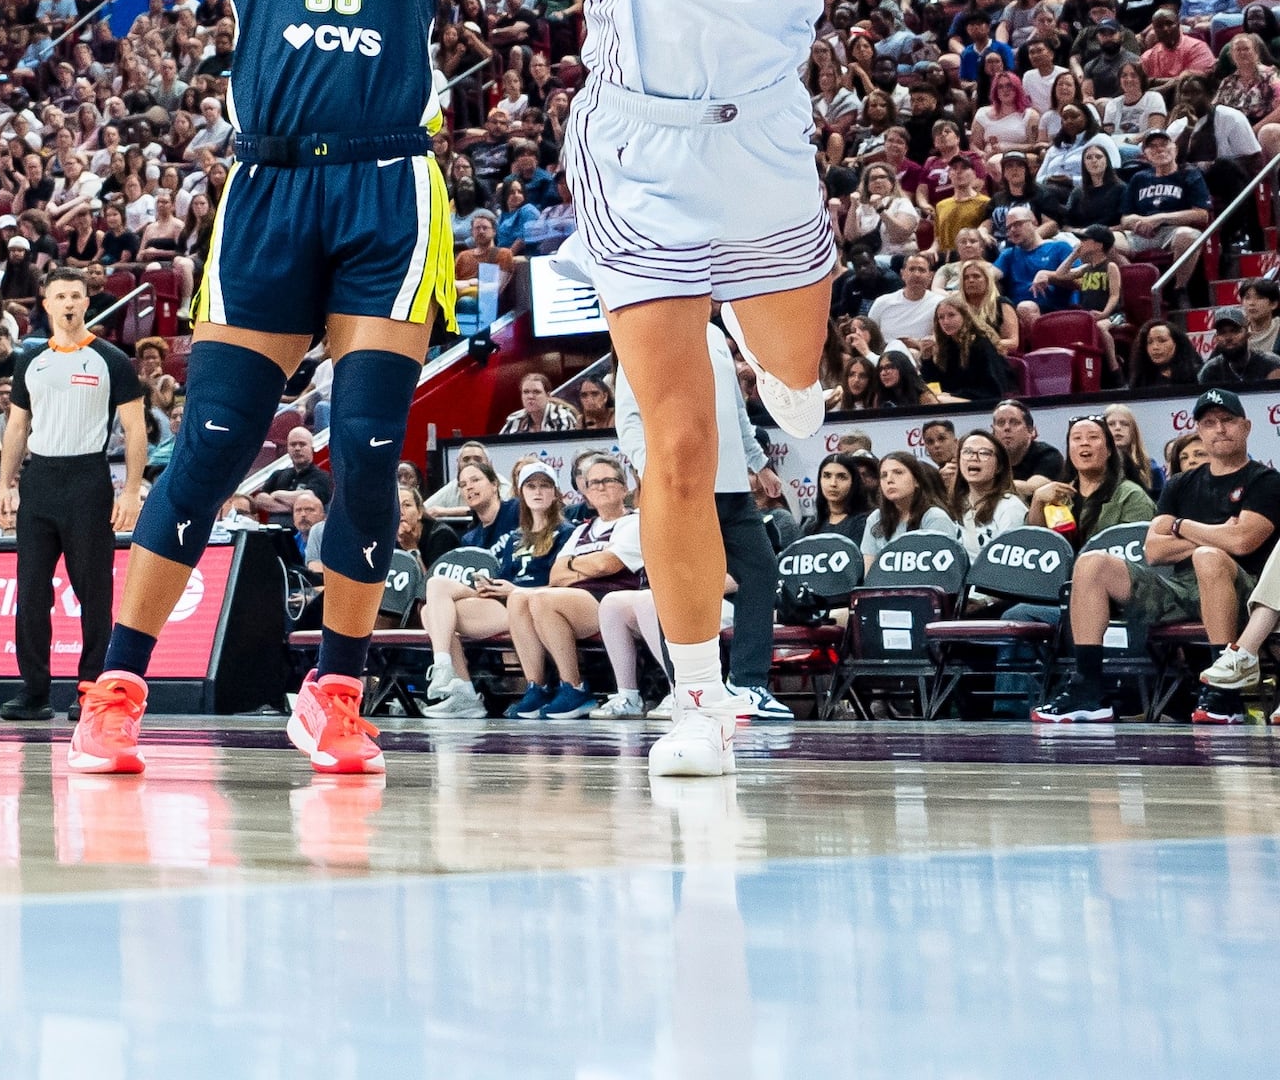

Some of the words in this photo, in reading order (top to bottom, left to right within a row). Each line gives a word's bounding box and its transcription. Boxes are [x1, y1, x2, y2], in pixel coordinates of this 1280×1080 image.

[314, 24, 383, 57] CVS
[1139, 184, 1182, 201] UCONN
[779, 553, 828, 575] CIBC
[879, 551, 932, 571] CIBC
[987, 543, 1040, 570] CIBC
[433, 561, 475, 587] CIBC
